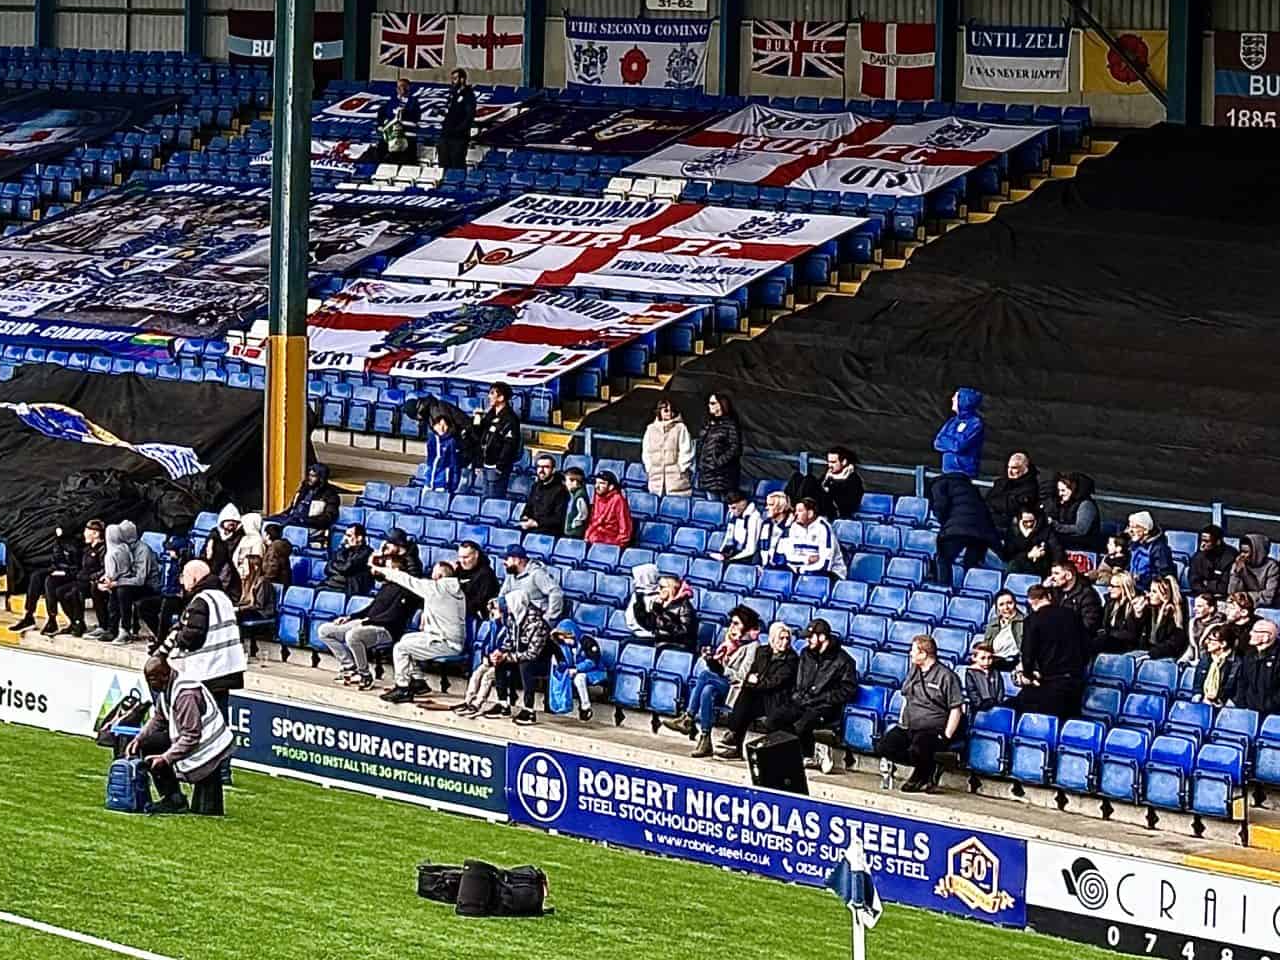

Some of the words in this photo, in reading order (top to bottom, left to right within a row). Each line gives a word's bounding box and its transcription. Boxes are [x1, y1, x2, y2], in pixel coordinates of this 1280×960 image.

[657, 0, 694, 9] 31-62
[570, 20, 597, 33] THE
[600, 22, 651, 36] SECOND
[654, 23, 708, 36] COMING
[252, 39, 274, 57] BU
[766, 40, 799, 52] BURY
[812, 41, 827, 53] FC
[971, 31, 1024, 49] UNTIL
[976, 67, 996, 78] WAS
[997, 68, 1030, 80] NEVER
[1031, 70, 1063, 80] HAPPY
[1226, 109, 1278, 129] 1885
[735, 135, 861, 157] BURY
[868, 144, 938, 165] FC
[510, 196, 664, 218] BEARDYMAN
[511, 230, 663, 250] BURY
[667, 240, 742, 258] FC
[611, 259, 645, 272] TWO
[228, 706, 251, 734] LE
[271, 717, 335, 747] SPORTS
[337, 729, 415, 763] SURFACE
[417, 745, 493, 778] EXPERTS
[308, 752, 322, 765] TO
[322, 755, 360, 773] INSTALL
[360, 763, 378, 777] THE
[378, 766, 393, 779] 3G
[393, 769, 422, 785] PITCH
[422, 774, 437, 787] AT
[436, 778, 462, 793] GIGG
[578, 766, 678, 811] ROBERT
[686, 788, 821, 839] NICHOLAS
[828, 816, 930, 861] STEELS
[578, 796, 616, 817] STEEL
[618, 803, 724, 838] STOCKHOLDERS
[726, 825, 738, 841] &
[741, 828, 793, 853] BUYERS
[795, 839, 816, 857] OF
[886, 859, 929, 881] STEEL
[959, 852, 987, 881] 50
